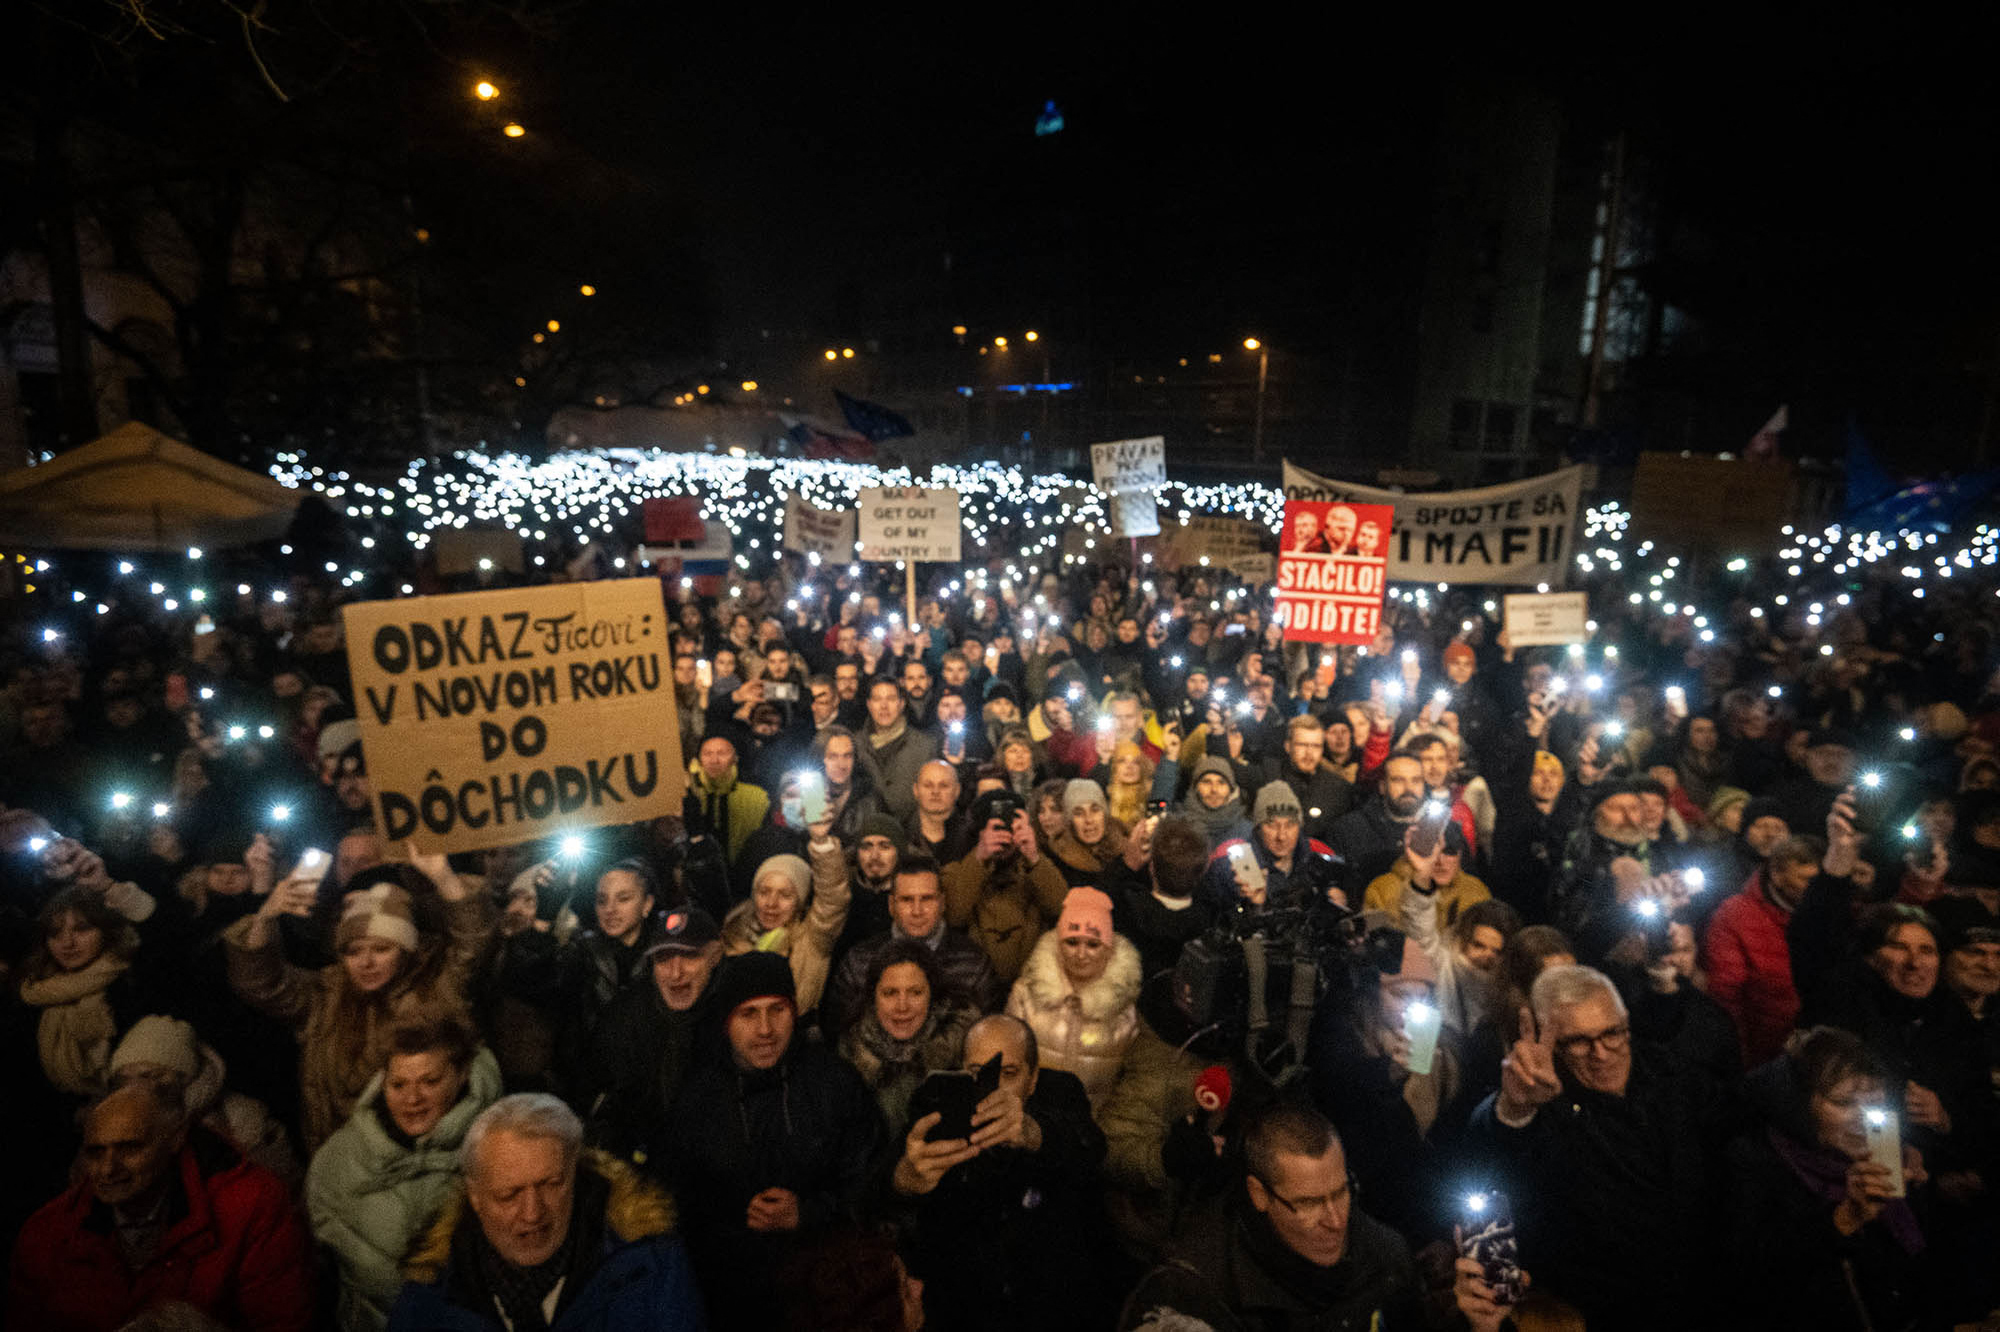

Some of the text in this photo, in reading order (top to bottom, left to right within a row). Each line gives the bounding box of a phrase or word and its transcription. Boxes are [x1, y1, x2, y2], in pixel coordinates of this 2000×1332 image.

[873, 507, 936, 520] GET OUT
[1415, 500, 1523, 526] SPOJTE
[1532, 492, 1567, 516] SA
[883, 527, 928, 539] OF MY
[1279, 559, 1384, 595] STAČILO!
[373, 611, 534, 675] ODKAZ
[366, 653, 661, 726] V NOVOM ROKU
[479, 715, 548, 763] DO
[379, 750, 659, 841] DÔCHODKU
